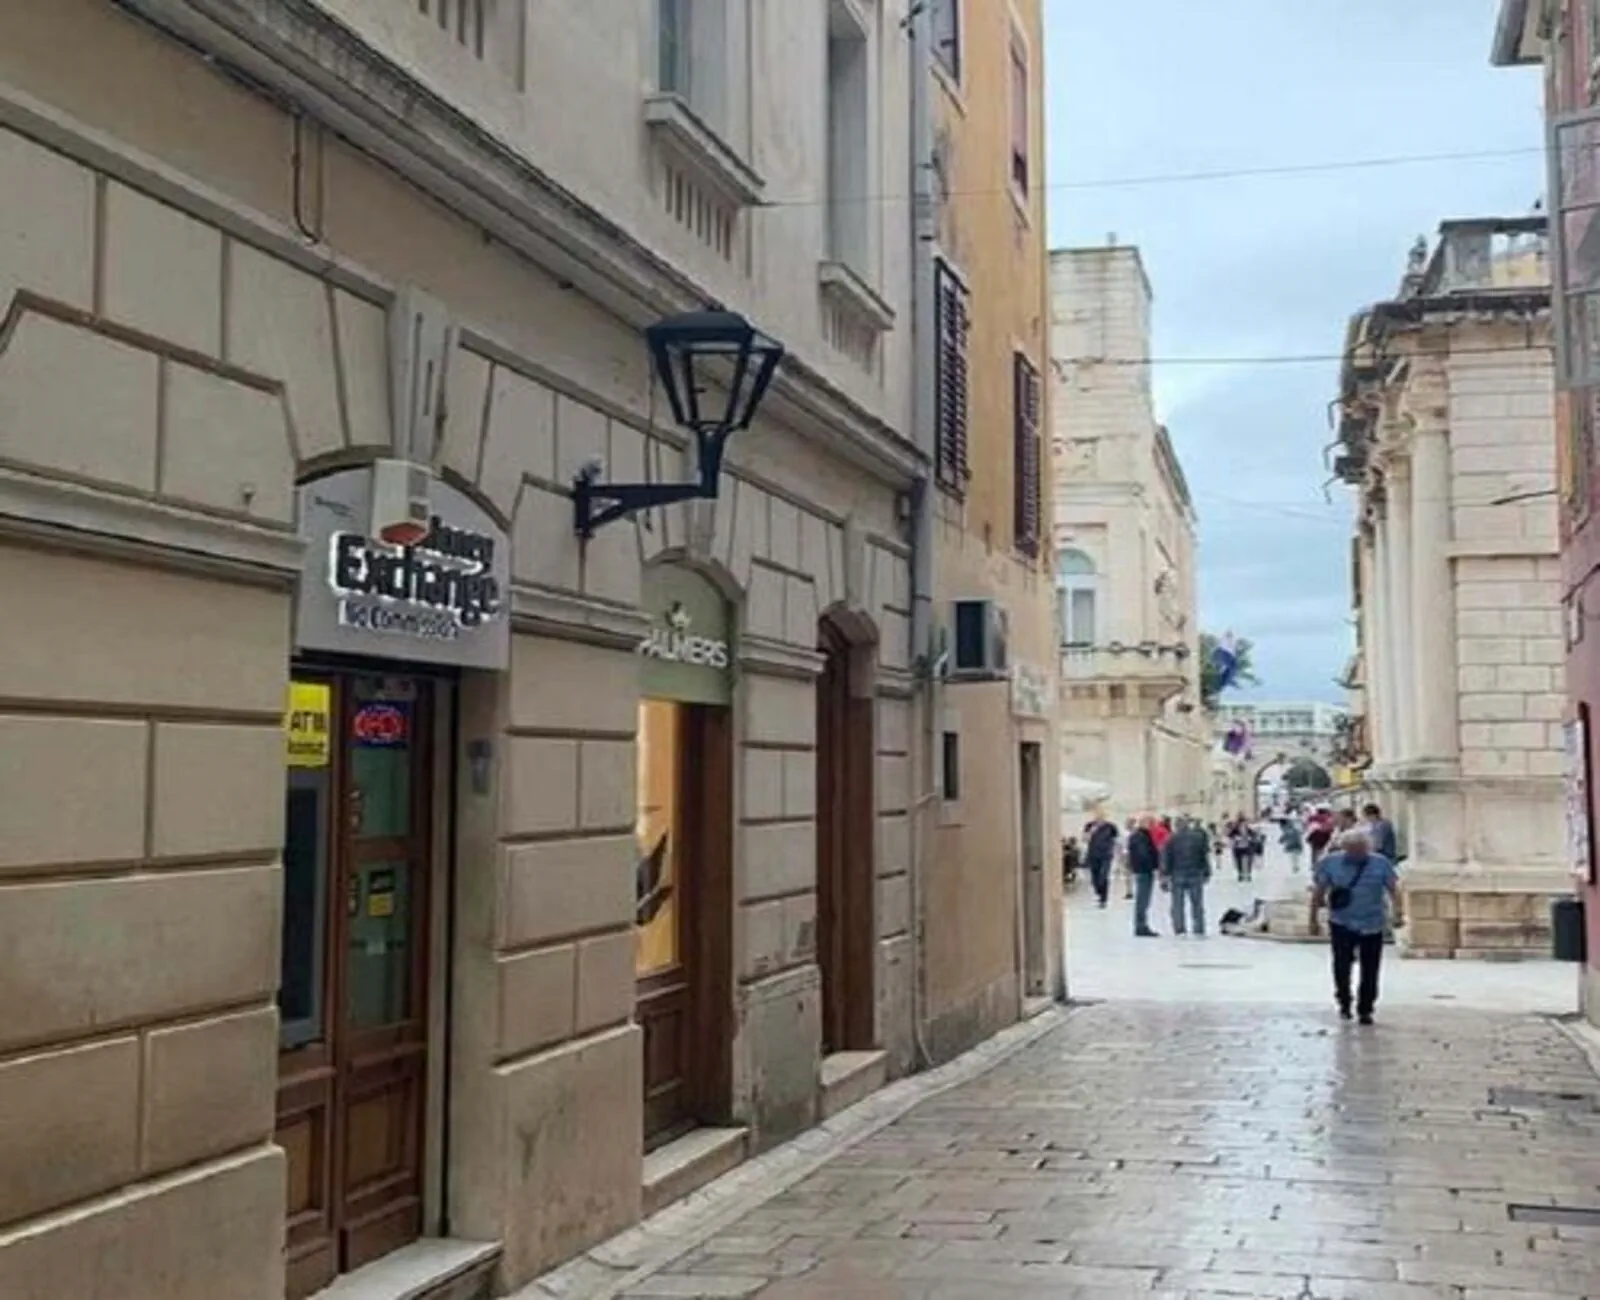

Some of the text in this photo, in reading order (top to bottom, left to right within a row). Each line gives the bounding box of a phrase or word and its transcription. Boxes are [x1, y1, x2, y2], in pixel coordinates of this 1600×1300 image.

[420, 514, 495, 569] oney
[329, 531, 499, 627] Exchange
[290, 711, 325, 733] ATM
